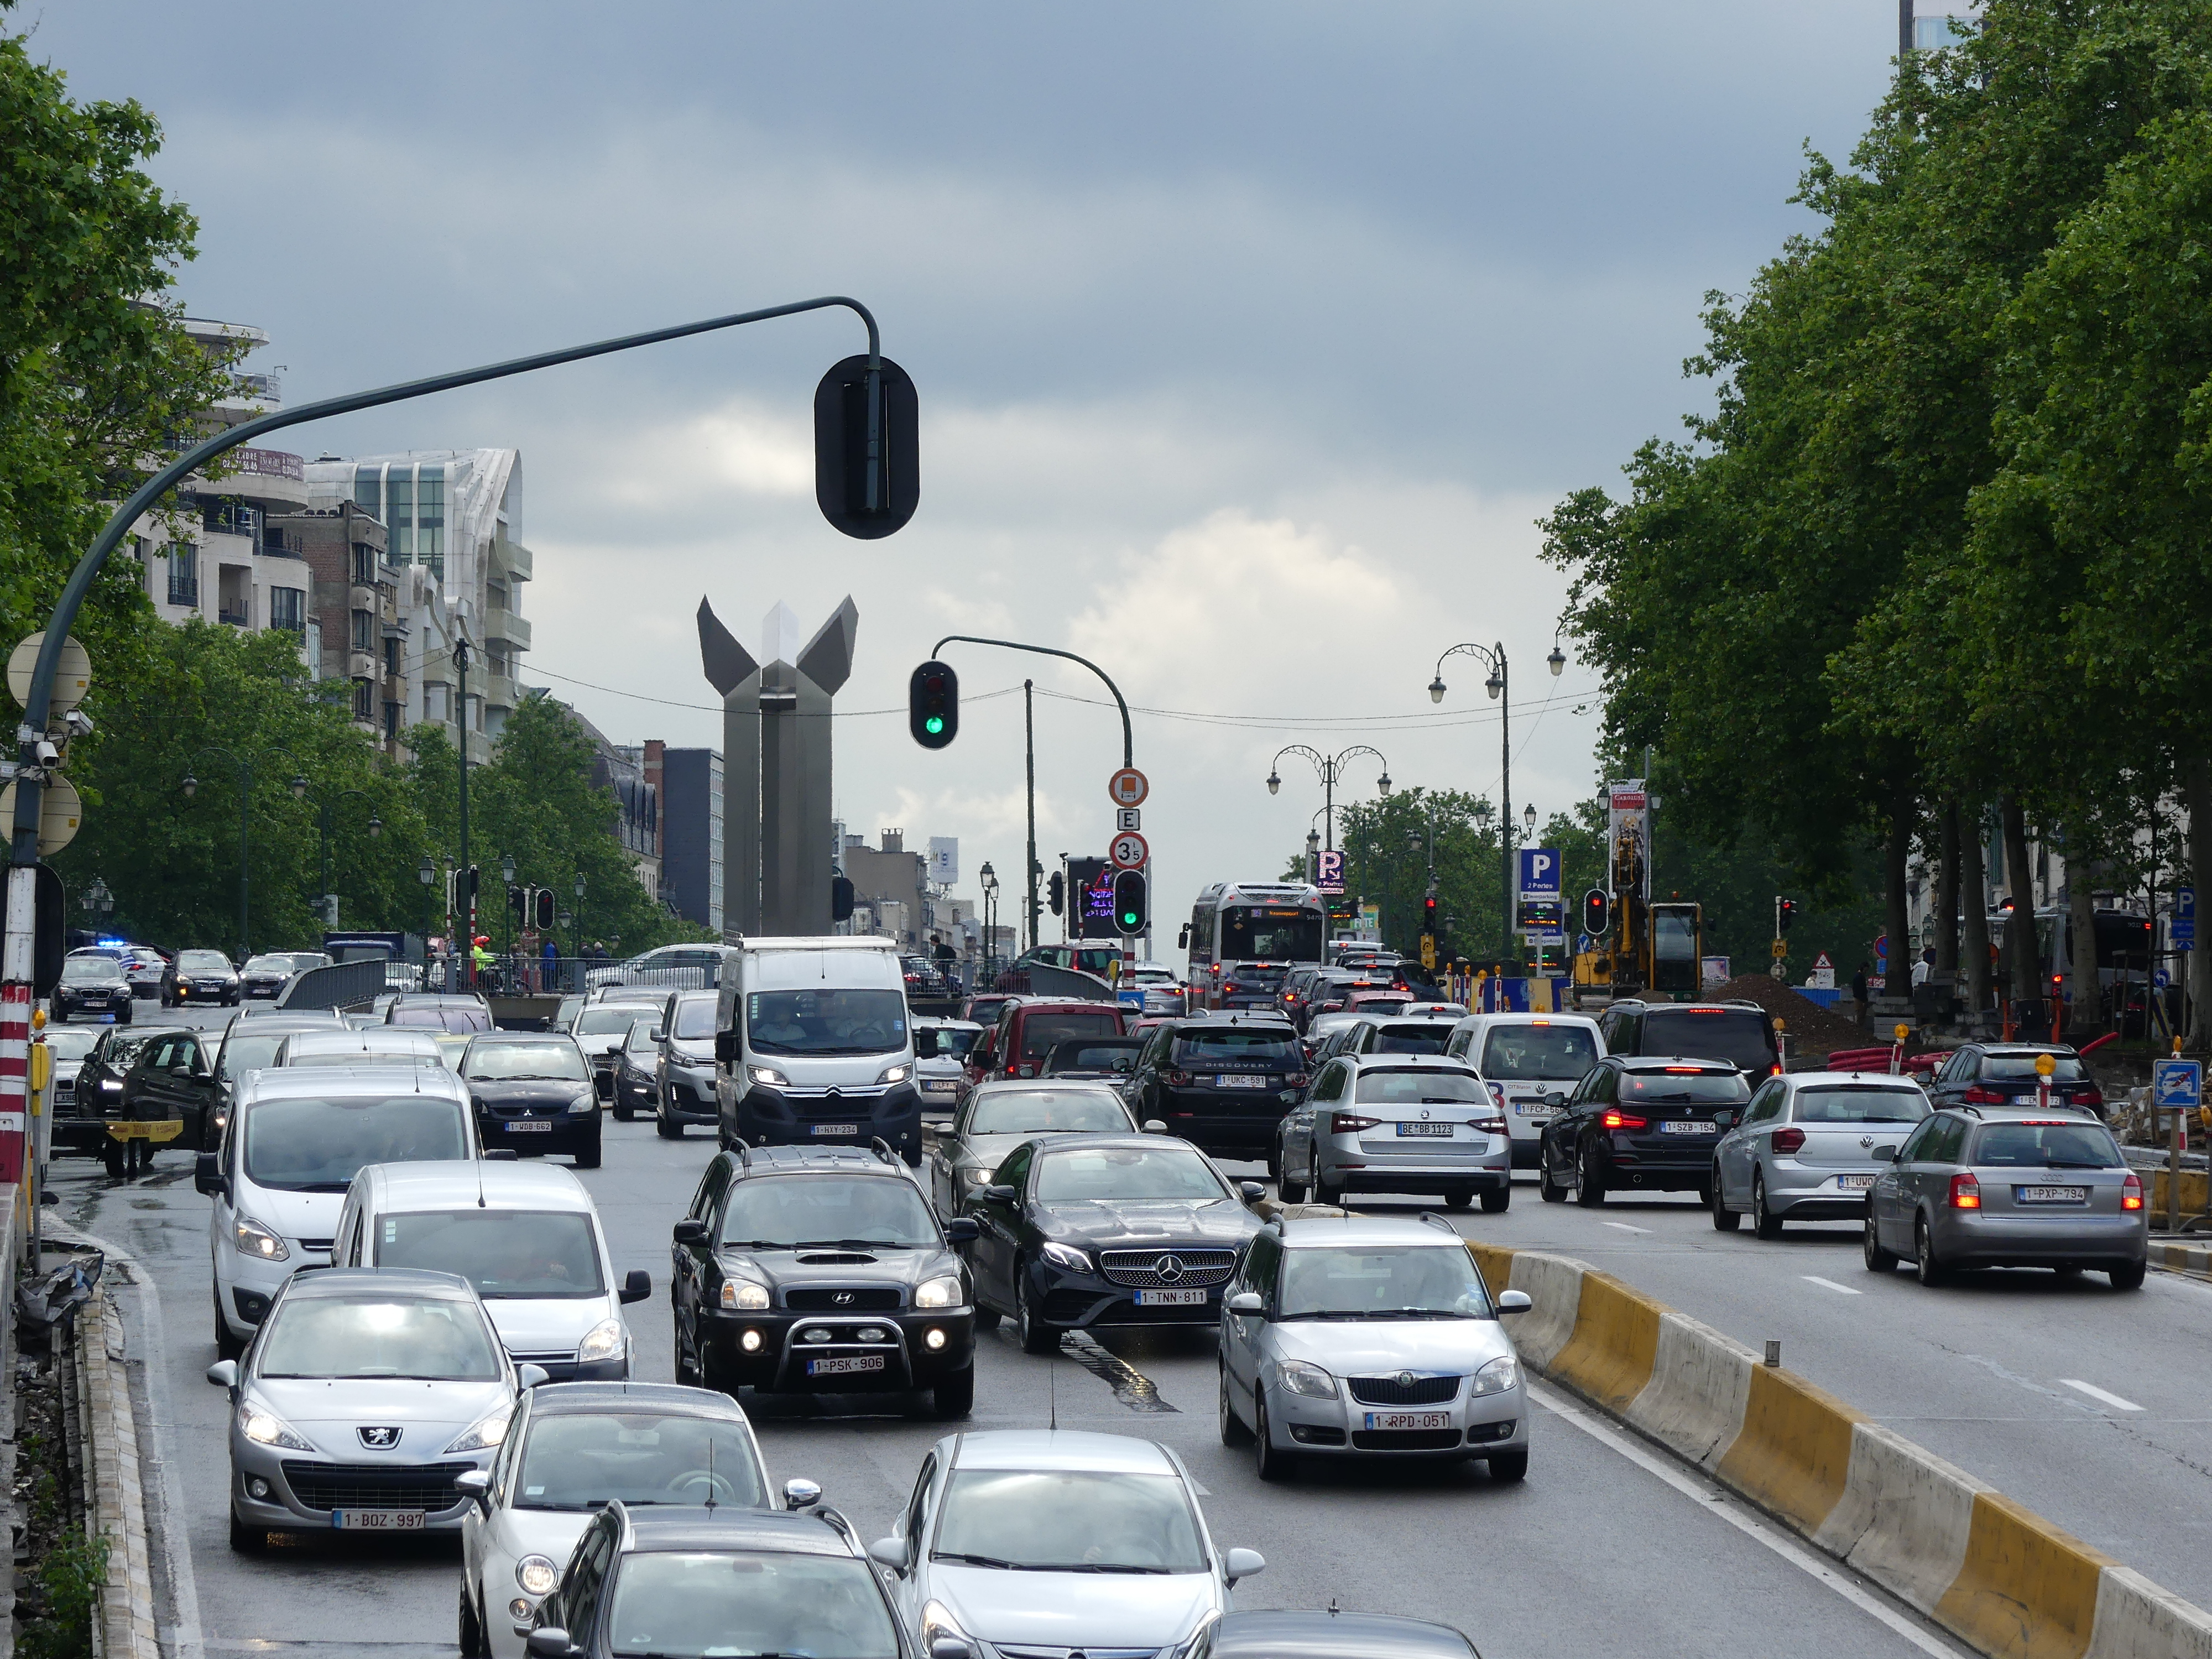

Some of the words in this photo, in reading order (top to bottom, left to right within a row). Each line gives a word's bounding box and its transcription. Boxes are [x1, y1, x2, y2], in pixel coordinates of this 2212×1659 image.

[232, 451, 257, 461] ENDRE
[1124, 812, 1134, 827] E
[1533, 854, 1551, 879] P
[2179, 892, 2194, 913] P
